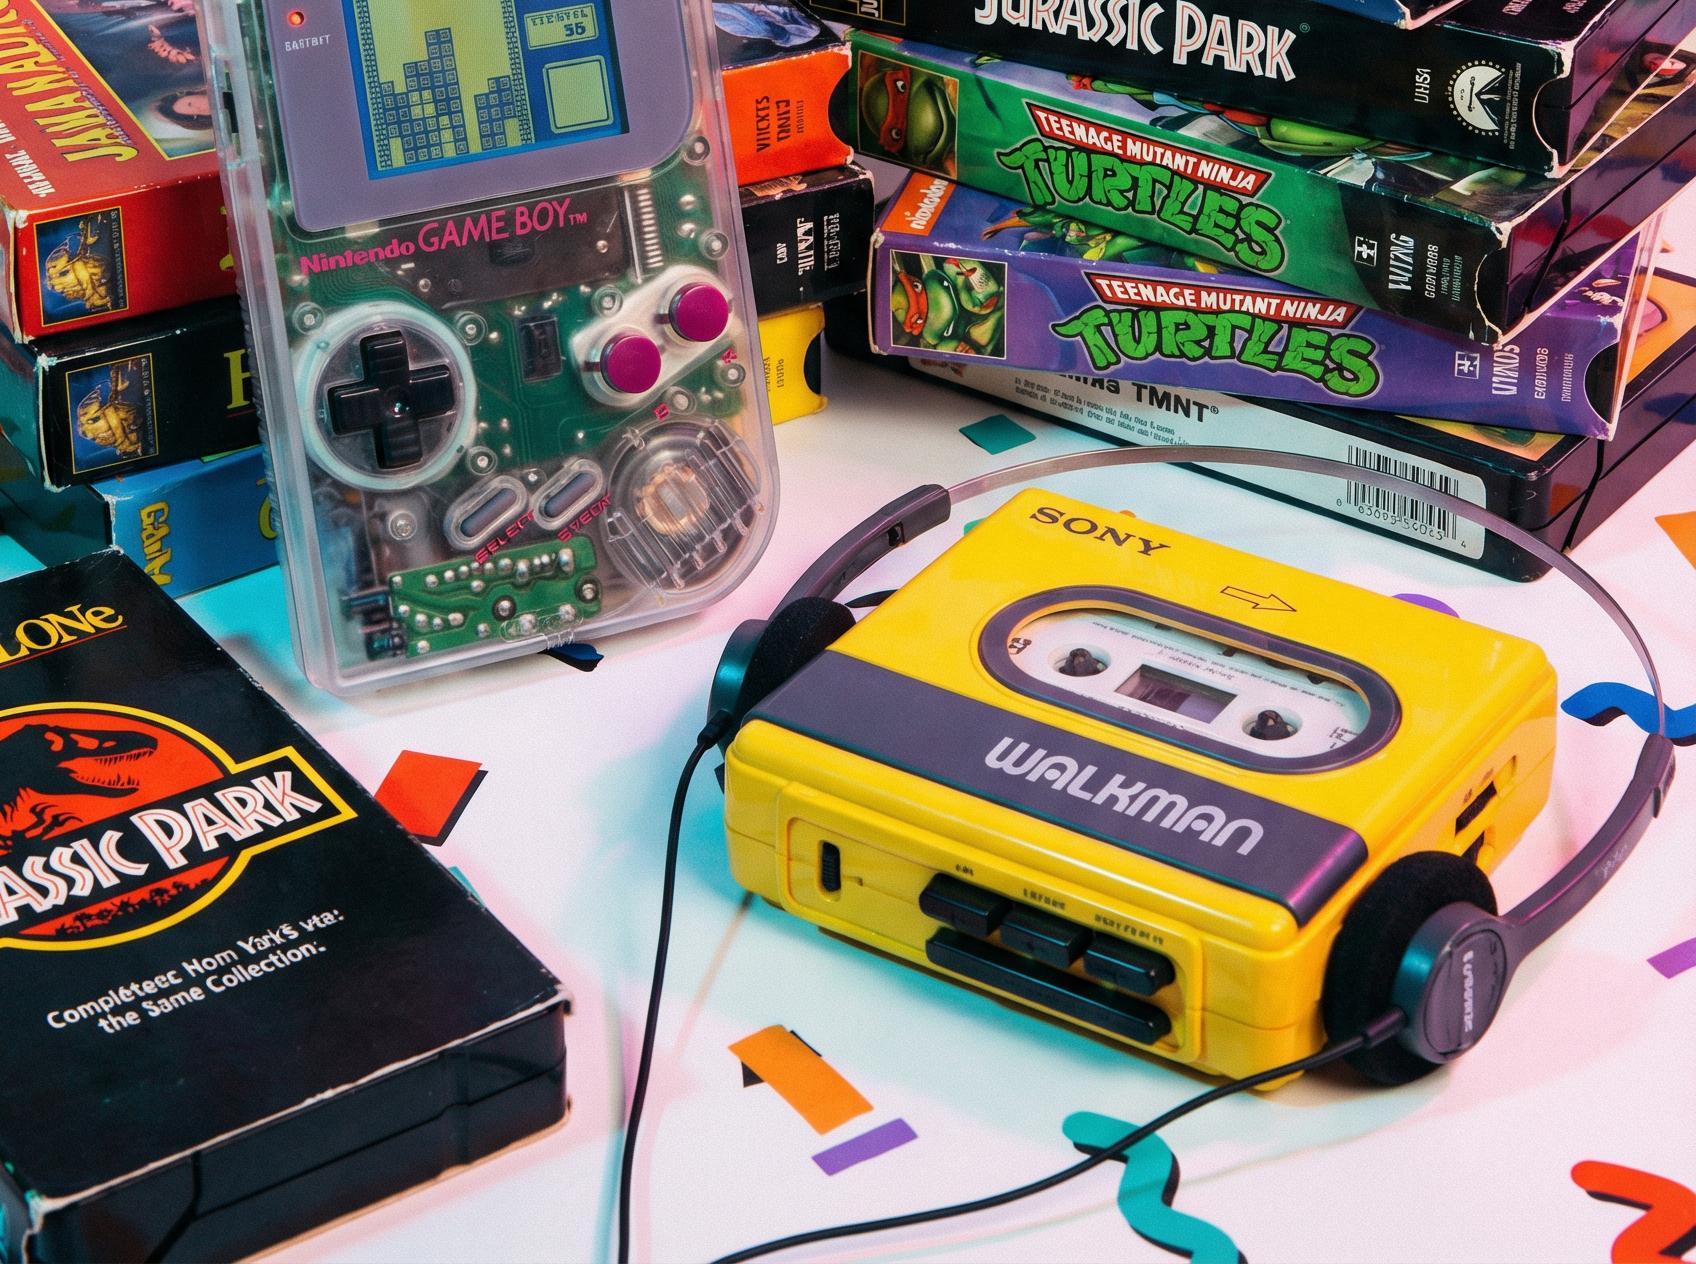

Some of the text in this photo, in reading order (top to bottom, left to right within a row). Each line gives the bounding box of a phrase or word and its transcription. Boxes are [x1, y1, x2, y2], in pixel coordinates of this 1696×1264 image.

[1036, 110, 1258, 192] TEENAGE MUTANT NINJA
[299, 238, 416, 276] Nintendo
[418, 210, 510, 254] GAME
[998, 138, 1287, 273] TURTLES
[1096, 278, 1349, 324] TEENAGE MUTANT NINJA
[1051, 305, 1382, 397] TURTLES
[1029, 504, 1171, 558] SONY
[129, 770, 324, 871] PARK
[984, 736, 1266, 856] WALKMAN
[98, 1010, 142, 1034] the
[141, 985, 206, 1018] Same
